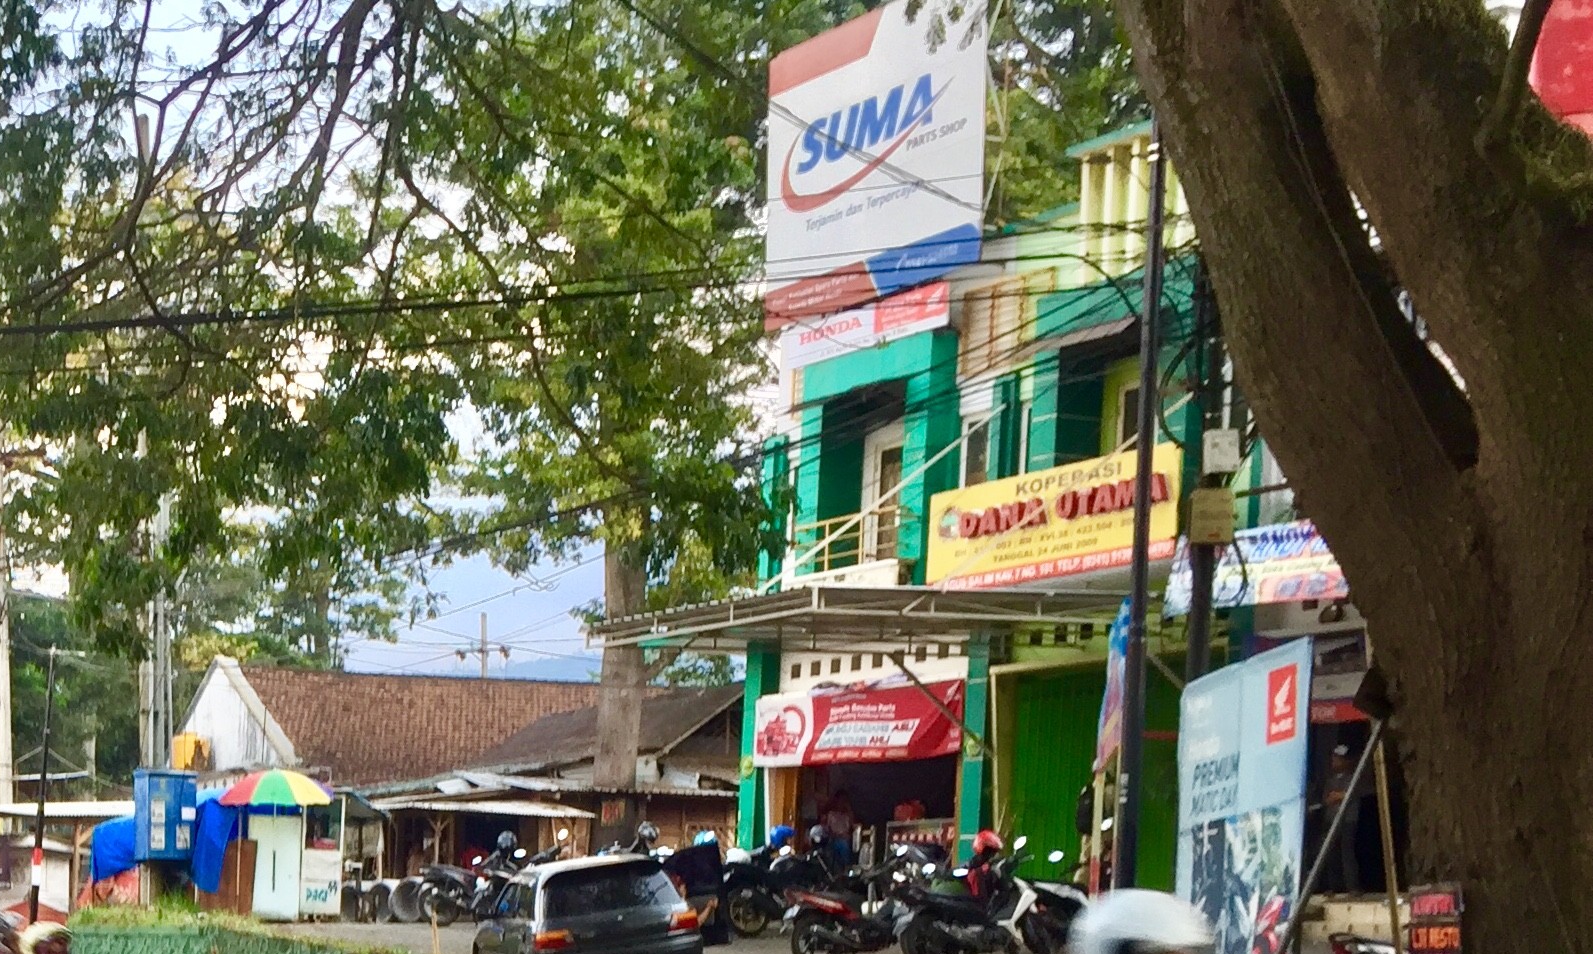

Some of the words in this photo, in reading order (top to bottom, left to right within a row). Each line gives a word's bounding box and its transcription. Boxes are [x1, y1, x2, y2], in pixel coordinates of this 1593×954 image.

[796, 73, 933, 175] SUMA
[906, 129, 937, 151] PARTS
[939, 117, 968, 139] SHOP
[806, 209, 843, 231] Terjamin
[799, 317, 862, 345] HONDA
[1015, 461, 1122, 497] KOPERASI
[959, 498, 1048, 539] DANA
[1056, 472, 1169, 520] UTAMA
[993, 550, 1033, 562] TANGGAL
[1192, 750, 1240, 790] PREMIUM
